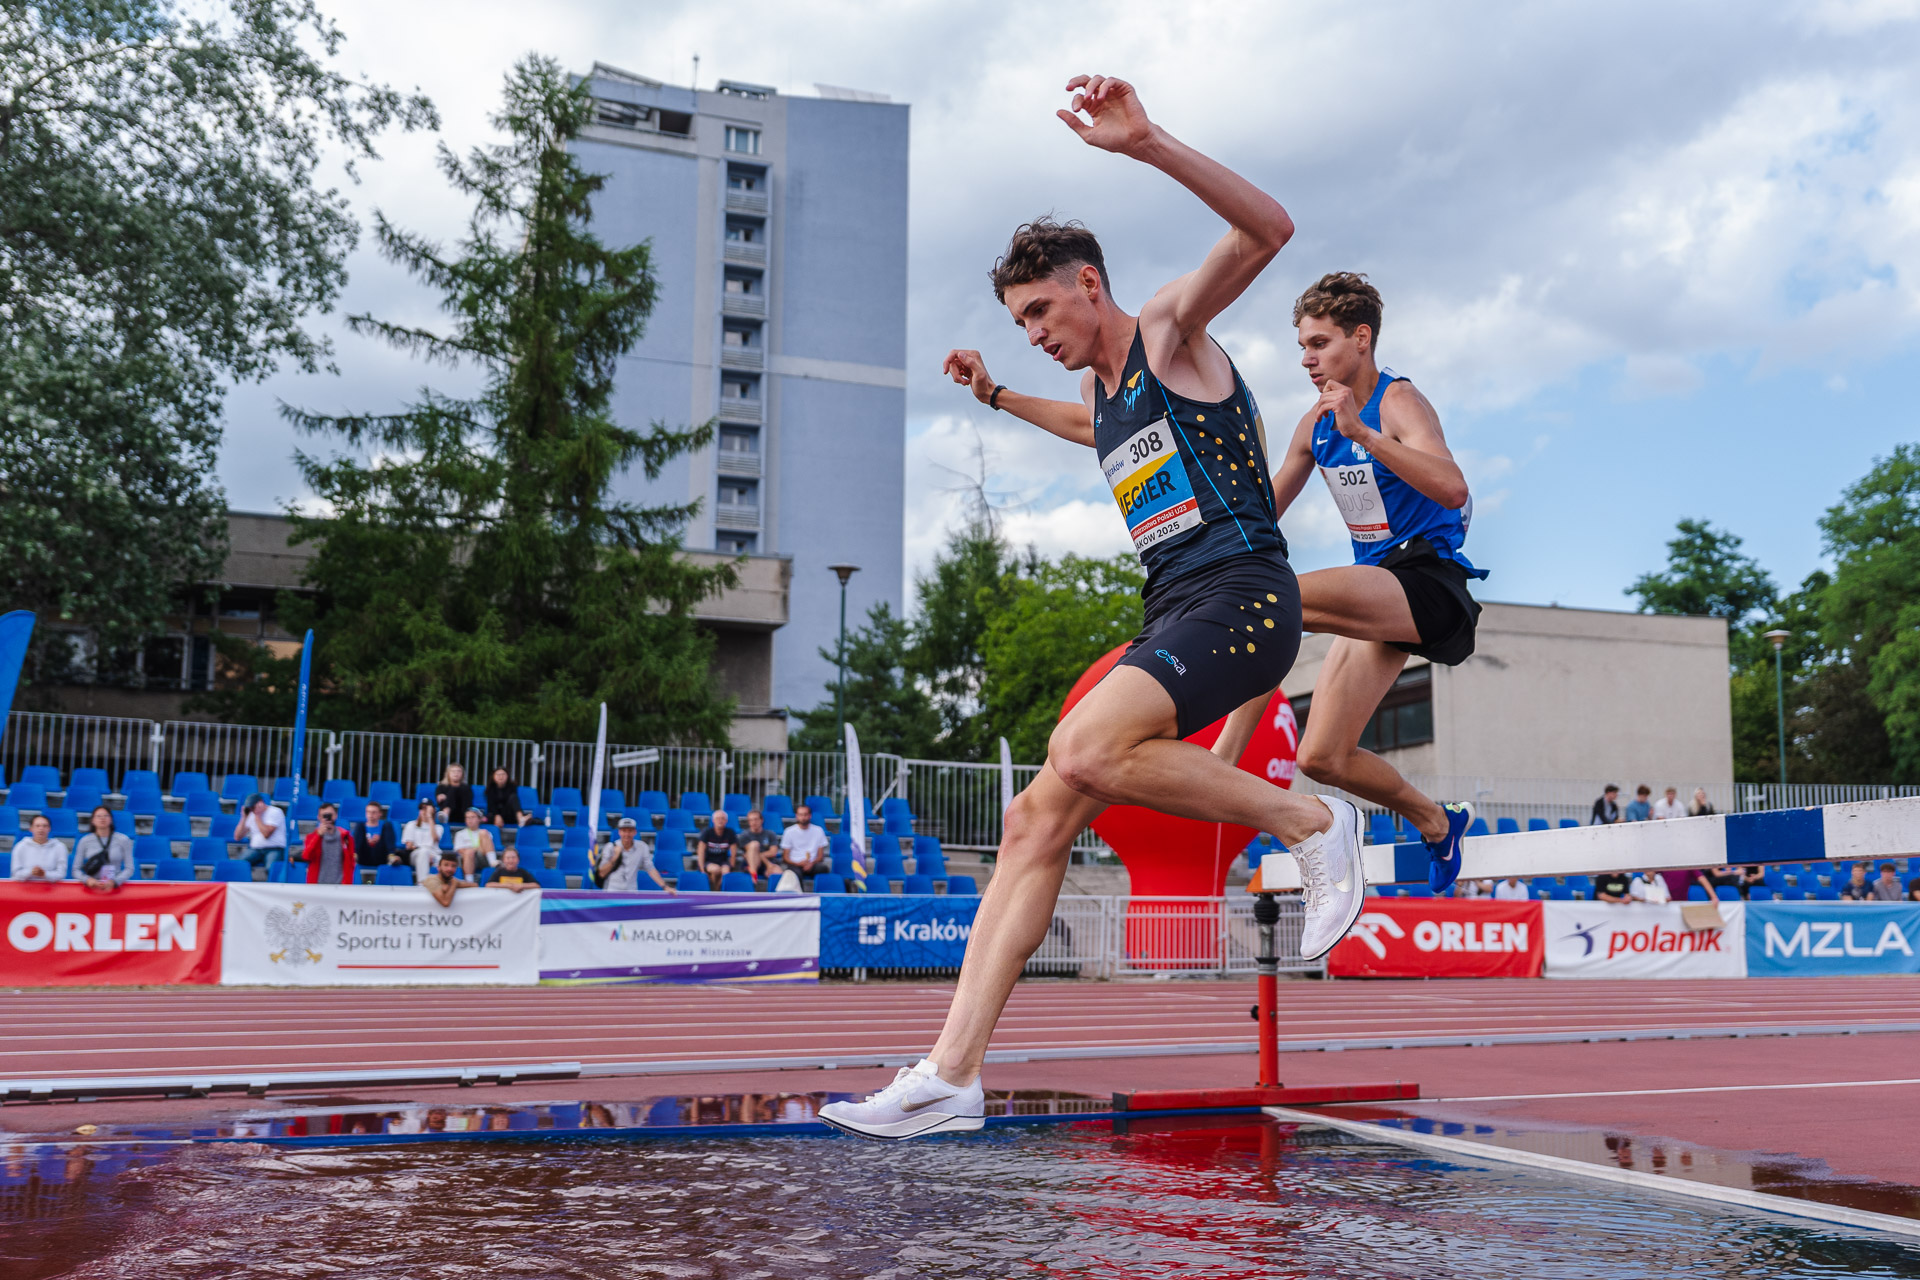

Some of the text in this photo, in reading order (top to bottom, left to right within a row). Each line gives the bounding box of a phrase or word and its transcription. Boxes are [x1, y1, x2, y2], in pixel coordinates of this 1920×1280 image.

[1129, 431, 1163, 465] 308
[1338, 469, 1368, 487] 502
[1157, 510, 1174, 523] Polski
[1174, 504, 1188, 515] U23
[1156, 521, 1180, 538] 2025
[337, 909, 464, 927] Ministerstwo
[7, 911, 198, 952] ORLEN
[632, 928, 734, 942] MAŁOPOLSKA
[894, 917, 972, 942] Kraków
[1413, 920, 1528, 953] ORLEN
[1764, 921, 1915, 958] MZLA
[336, 931, 502, 953] Sportu i Turystyki
[666, 948, 694, 957] Arena
[1606, 923, 1724, 960] polanik
